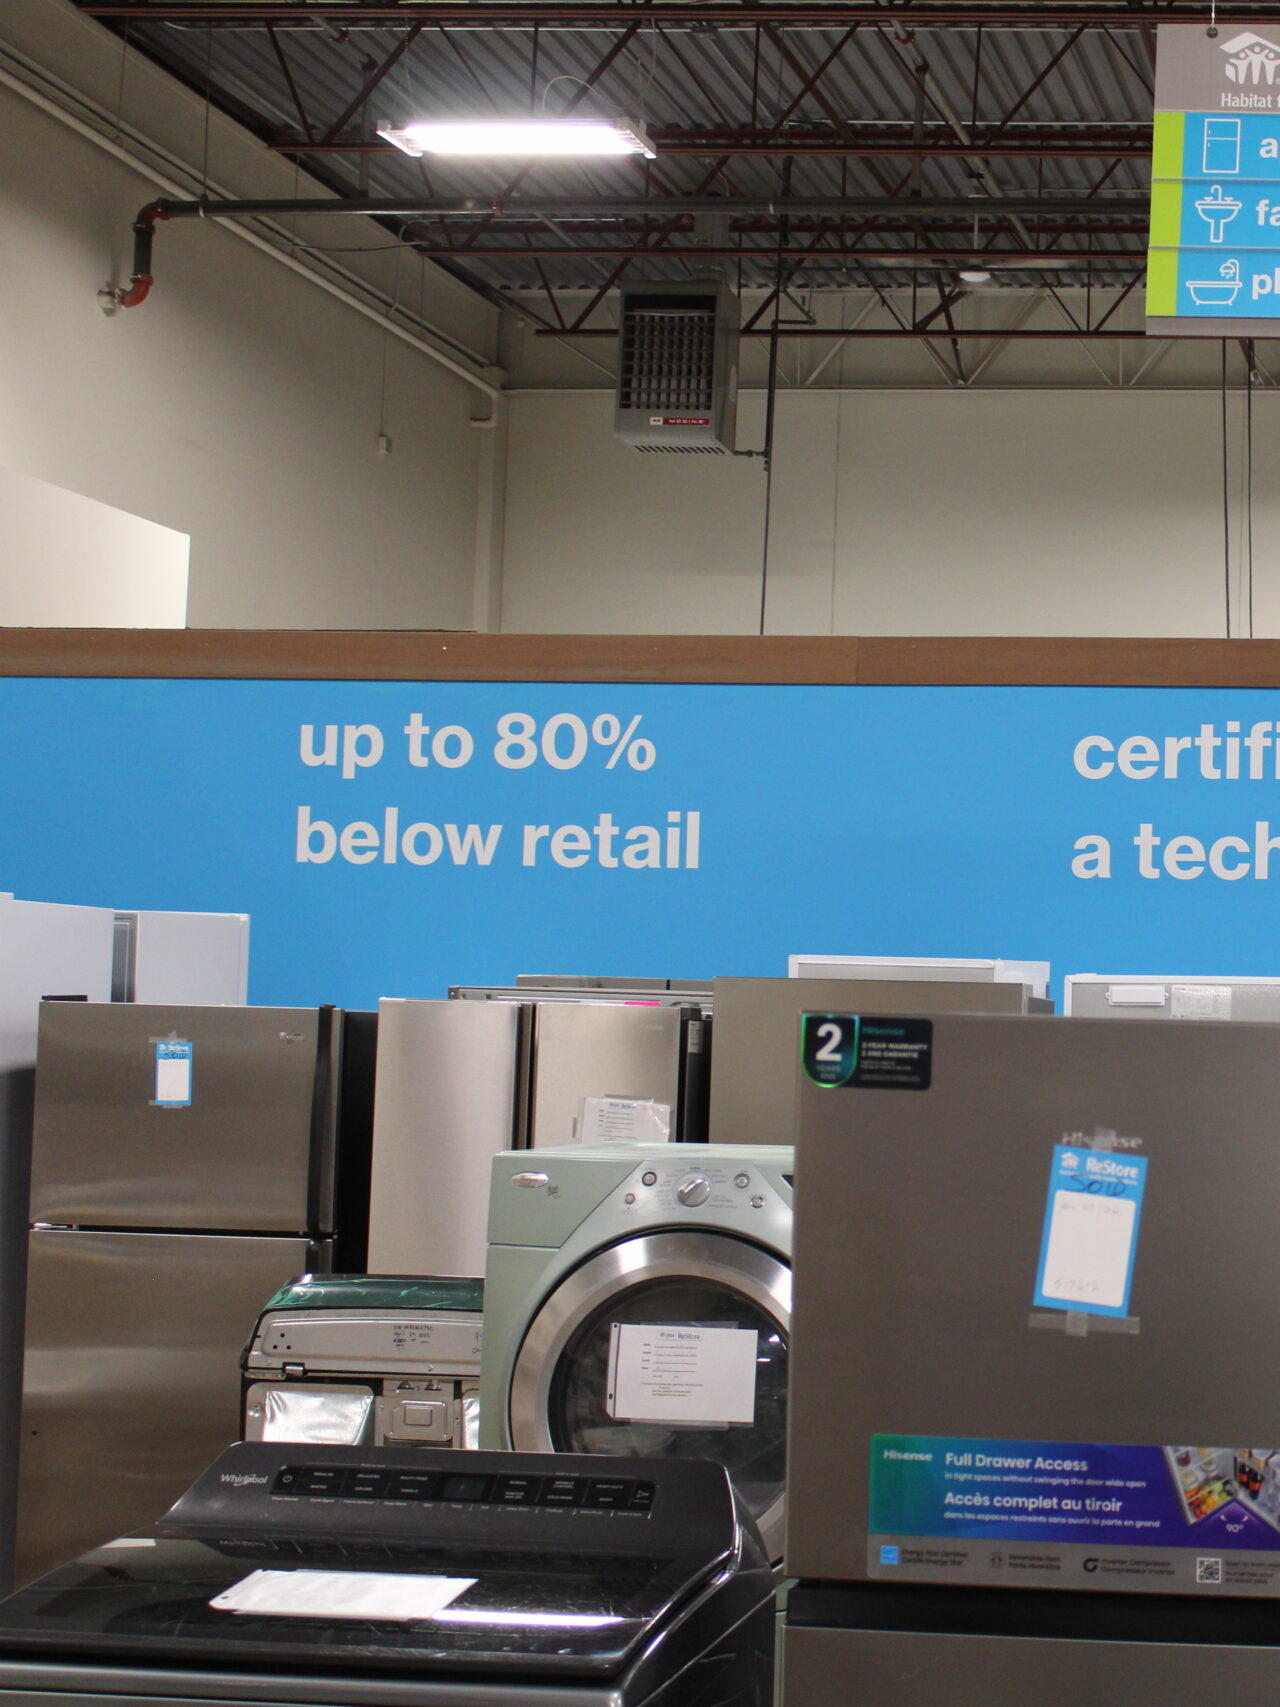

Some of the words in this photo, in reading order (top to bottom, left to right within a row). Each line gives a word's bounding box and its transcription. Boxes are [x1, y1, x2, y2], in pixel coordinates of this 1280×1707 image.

[1220, 92, 1273, 108] Habitat
[299, 724, 385, 780] up
[404, 712, 474, 768] to
[493, 712, 657, 772] 80%
[296, 806, 504, 867] below
[522, 810, 701, 869] retail
[1071, 834, 1112, 879] a
[815, 1022, 843, 1062] 2
[1085, 1157, 1140, 1179] ReStore
[884, 1449, 933, 1462] Hisense
[945, 1452, 972, 1467] Full
[975, 1454, 1032, 1469] Drawer
[1034, 1456, 1088, 1472] Access
[220, 1473, 268, 1487] Whirlpool
[1125, 1481, 1147, 1489] open
[944, 1491, 990, 1506] Accès
[993, 1494, 1058, 1512] complet
[1061, 1498, 1082, 1510] au
[1084, 1497, 1122, 1513] tiroir
